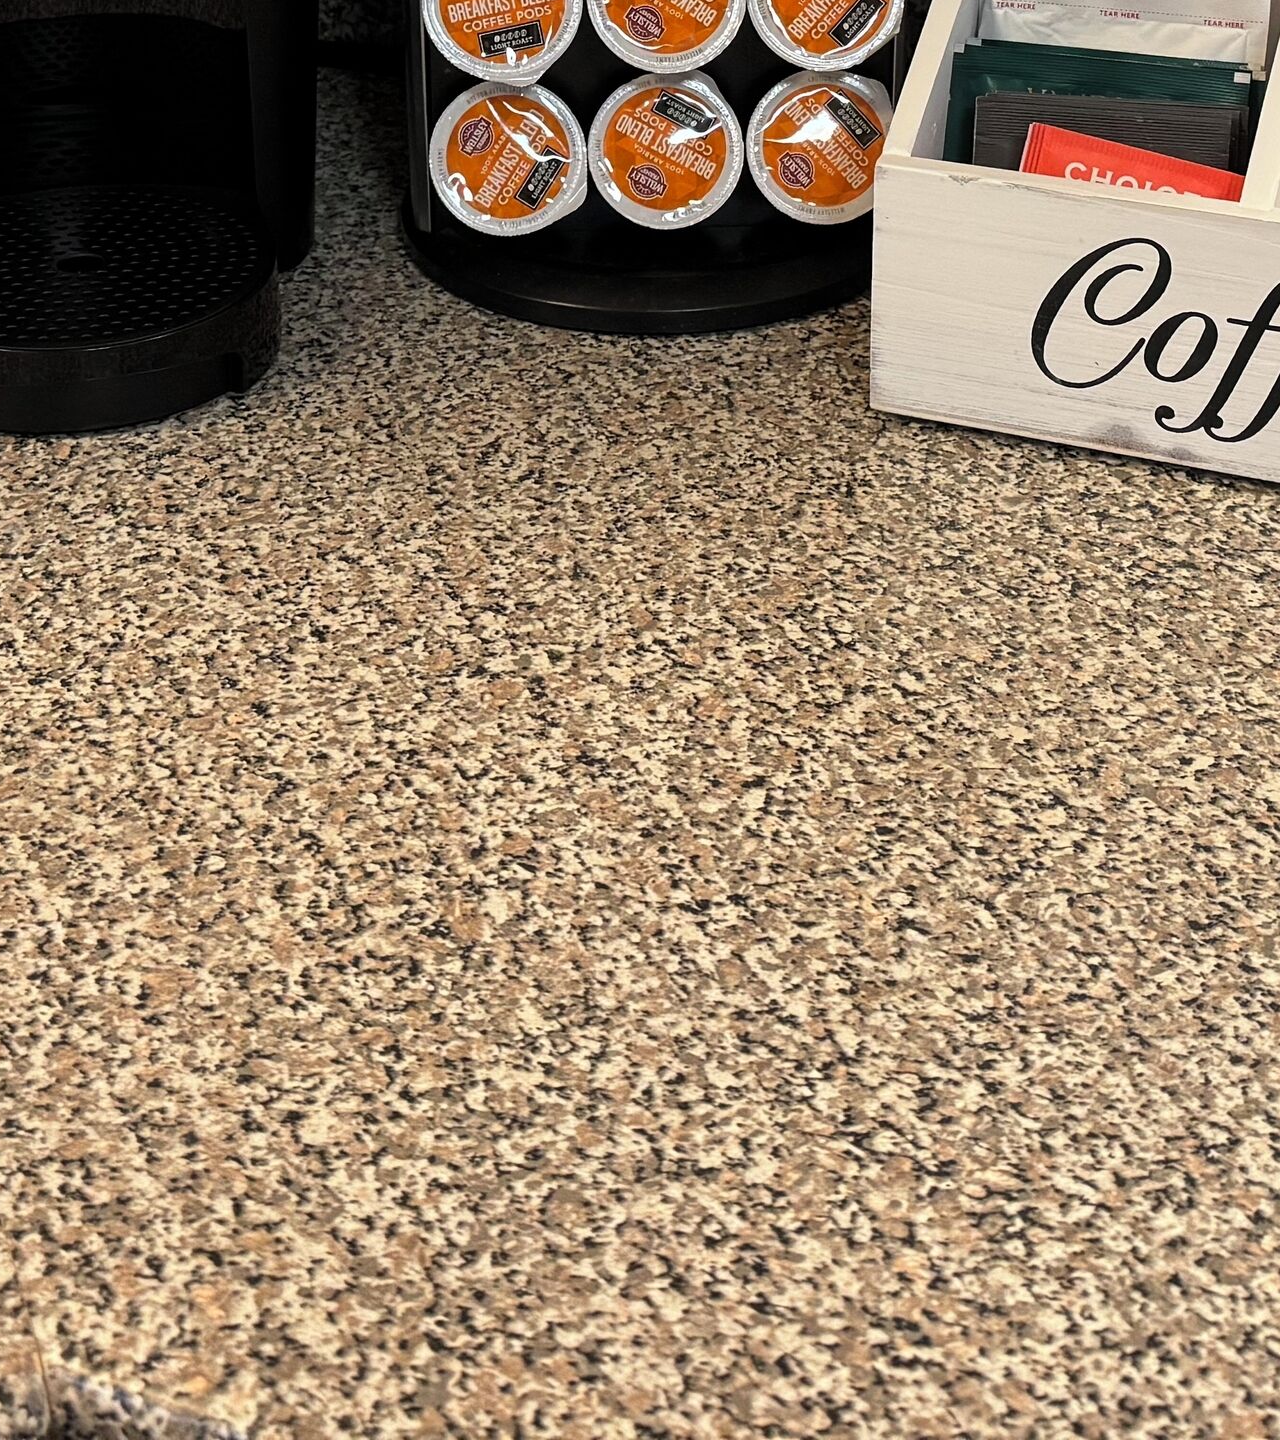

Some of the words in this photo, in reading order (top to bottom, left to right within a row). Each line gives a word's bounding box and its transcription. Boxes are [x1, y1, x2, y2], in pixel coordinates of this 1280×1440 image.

[462, 13, 512, 33] COFFEE
[516, 4, 552, 21] PODS
[996, 1, 1015, 10] TEAR
[1017, 2, 1036, 10] HERE
[1100, 10, 1118, 18] TEAR
[1121, 12, 1140, 20] HERE
[628, 8, 663, 36] WELLSLEY
[1204, 19, 1223, 28] TEAR
[1225, 20, 1245, 30] HERE
[490, 41, 511, 51] LIGHT
[613, 112, 655, 146] BLEND
[632, 106, 667, 131] PODS
[462, 119, 489, 154] WELLSLEY
[631, 142, 664, 165] ARABICA
[650, 132, 717, 180] BREAKFAST
[473, 141, 524, 209] BREAKFAST
[495, 159, 530, 206] COFFEE
[629, 168, 665, 194] WELLSLEY
[781, 153, 811, 186] WELLSLEY
